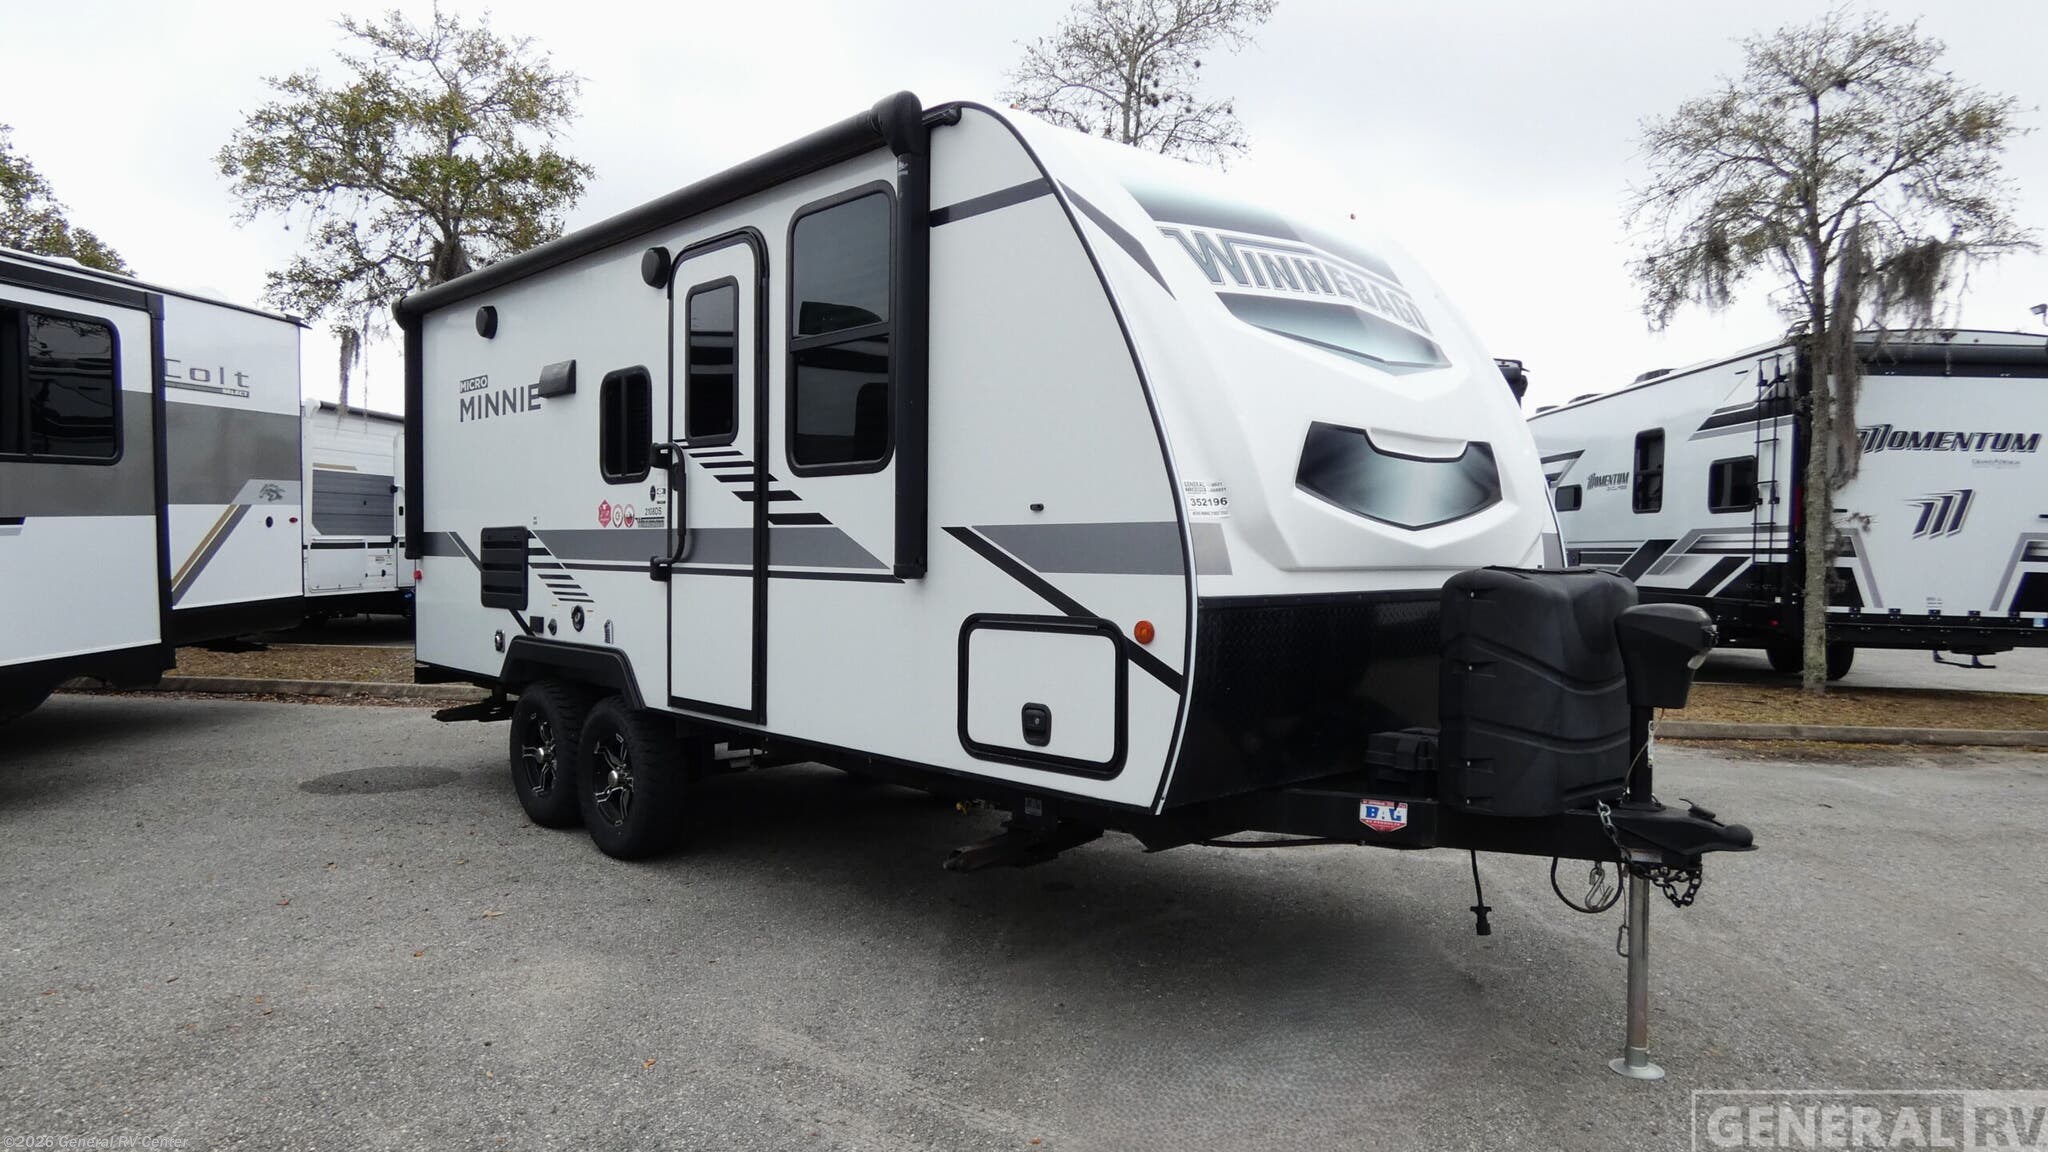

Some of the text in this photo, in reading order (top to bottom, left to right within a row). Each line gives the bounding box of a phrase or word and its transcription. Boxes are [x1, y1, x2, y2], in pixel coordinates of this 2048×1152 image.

[1157, 227, 1432, 334] WINNEBAGO
[460, 375, 488, 392] MICRO
[460, 383, 542, 422] MINNIE
[1190, 497, 1228, 507] 352196
